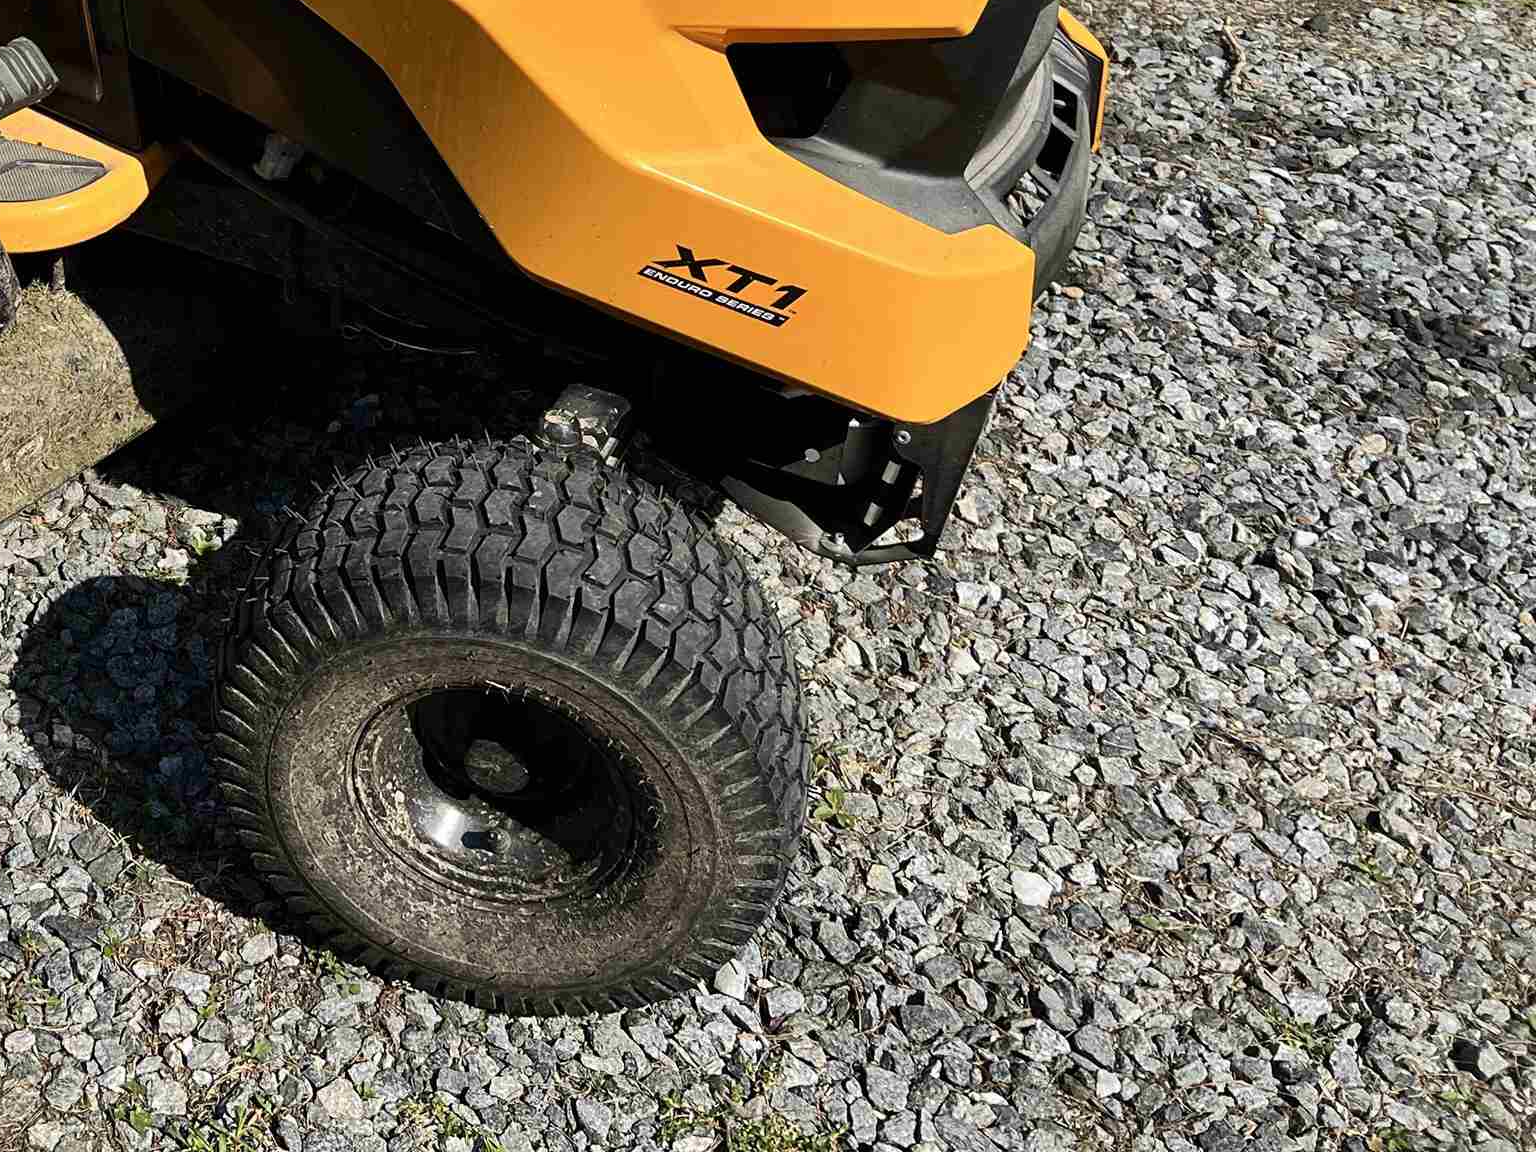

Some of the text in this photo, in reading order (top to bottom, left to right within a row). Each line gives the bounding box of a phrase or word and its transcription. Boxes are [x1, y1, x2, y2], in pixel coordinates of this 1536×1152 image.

[643, 268, 775, 321] ENDURO SERIES
[651, 244, 808, 310] XT1
